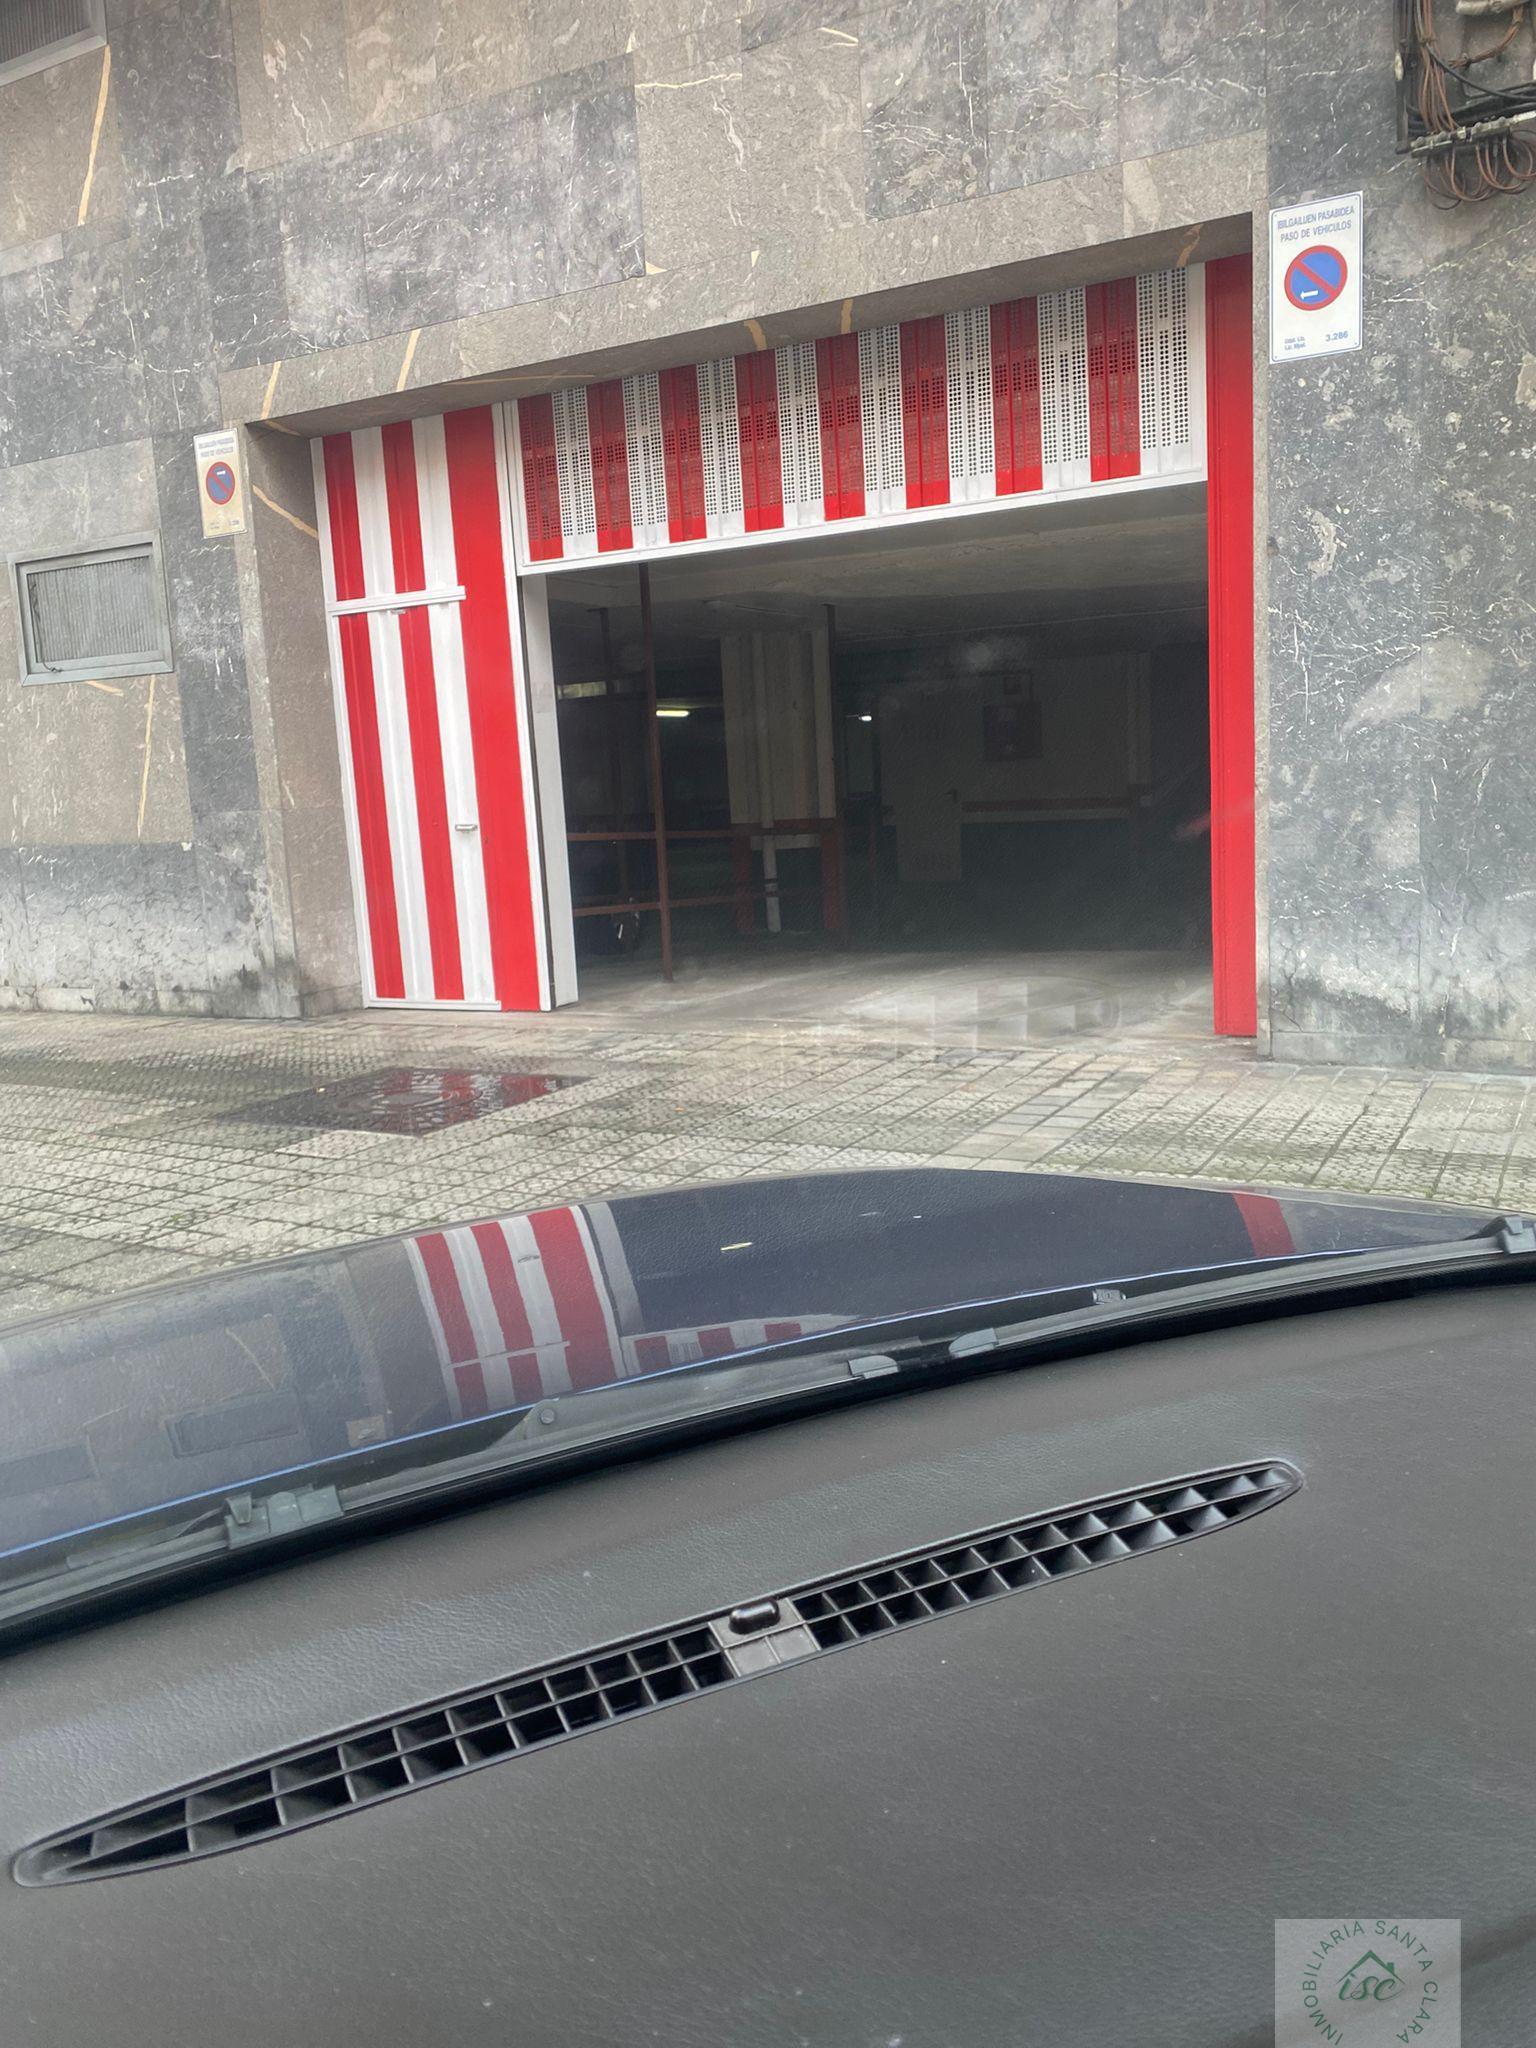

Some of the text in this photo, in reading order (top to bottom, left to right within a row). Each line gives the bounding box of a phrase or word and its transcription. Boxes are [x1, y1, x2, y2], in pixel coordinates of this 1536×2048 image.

[1317, 206, 1354, 222] PASABIDEA
[1280, 230, 1298, 242] PASO
[1301, 228, 1311, 239] DE
[1325, 330, 1349, 342] 3.286
